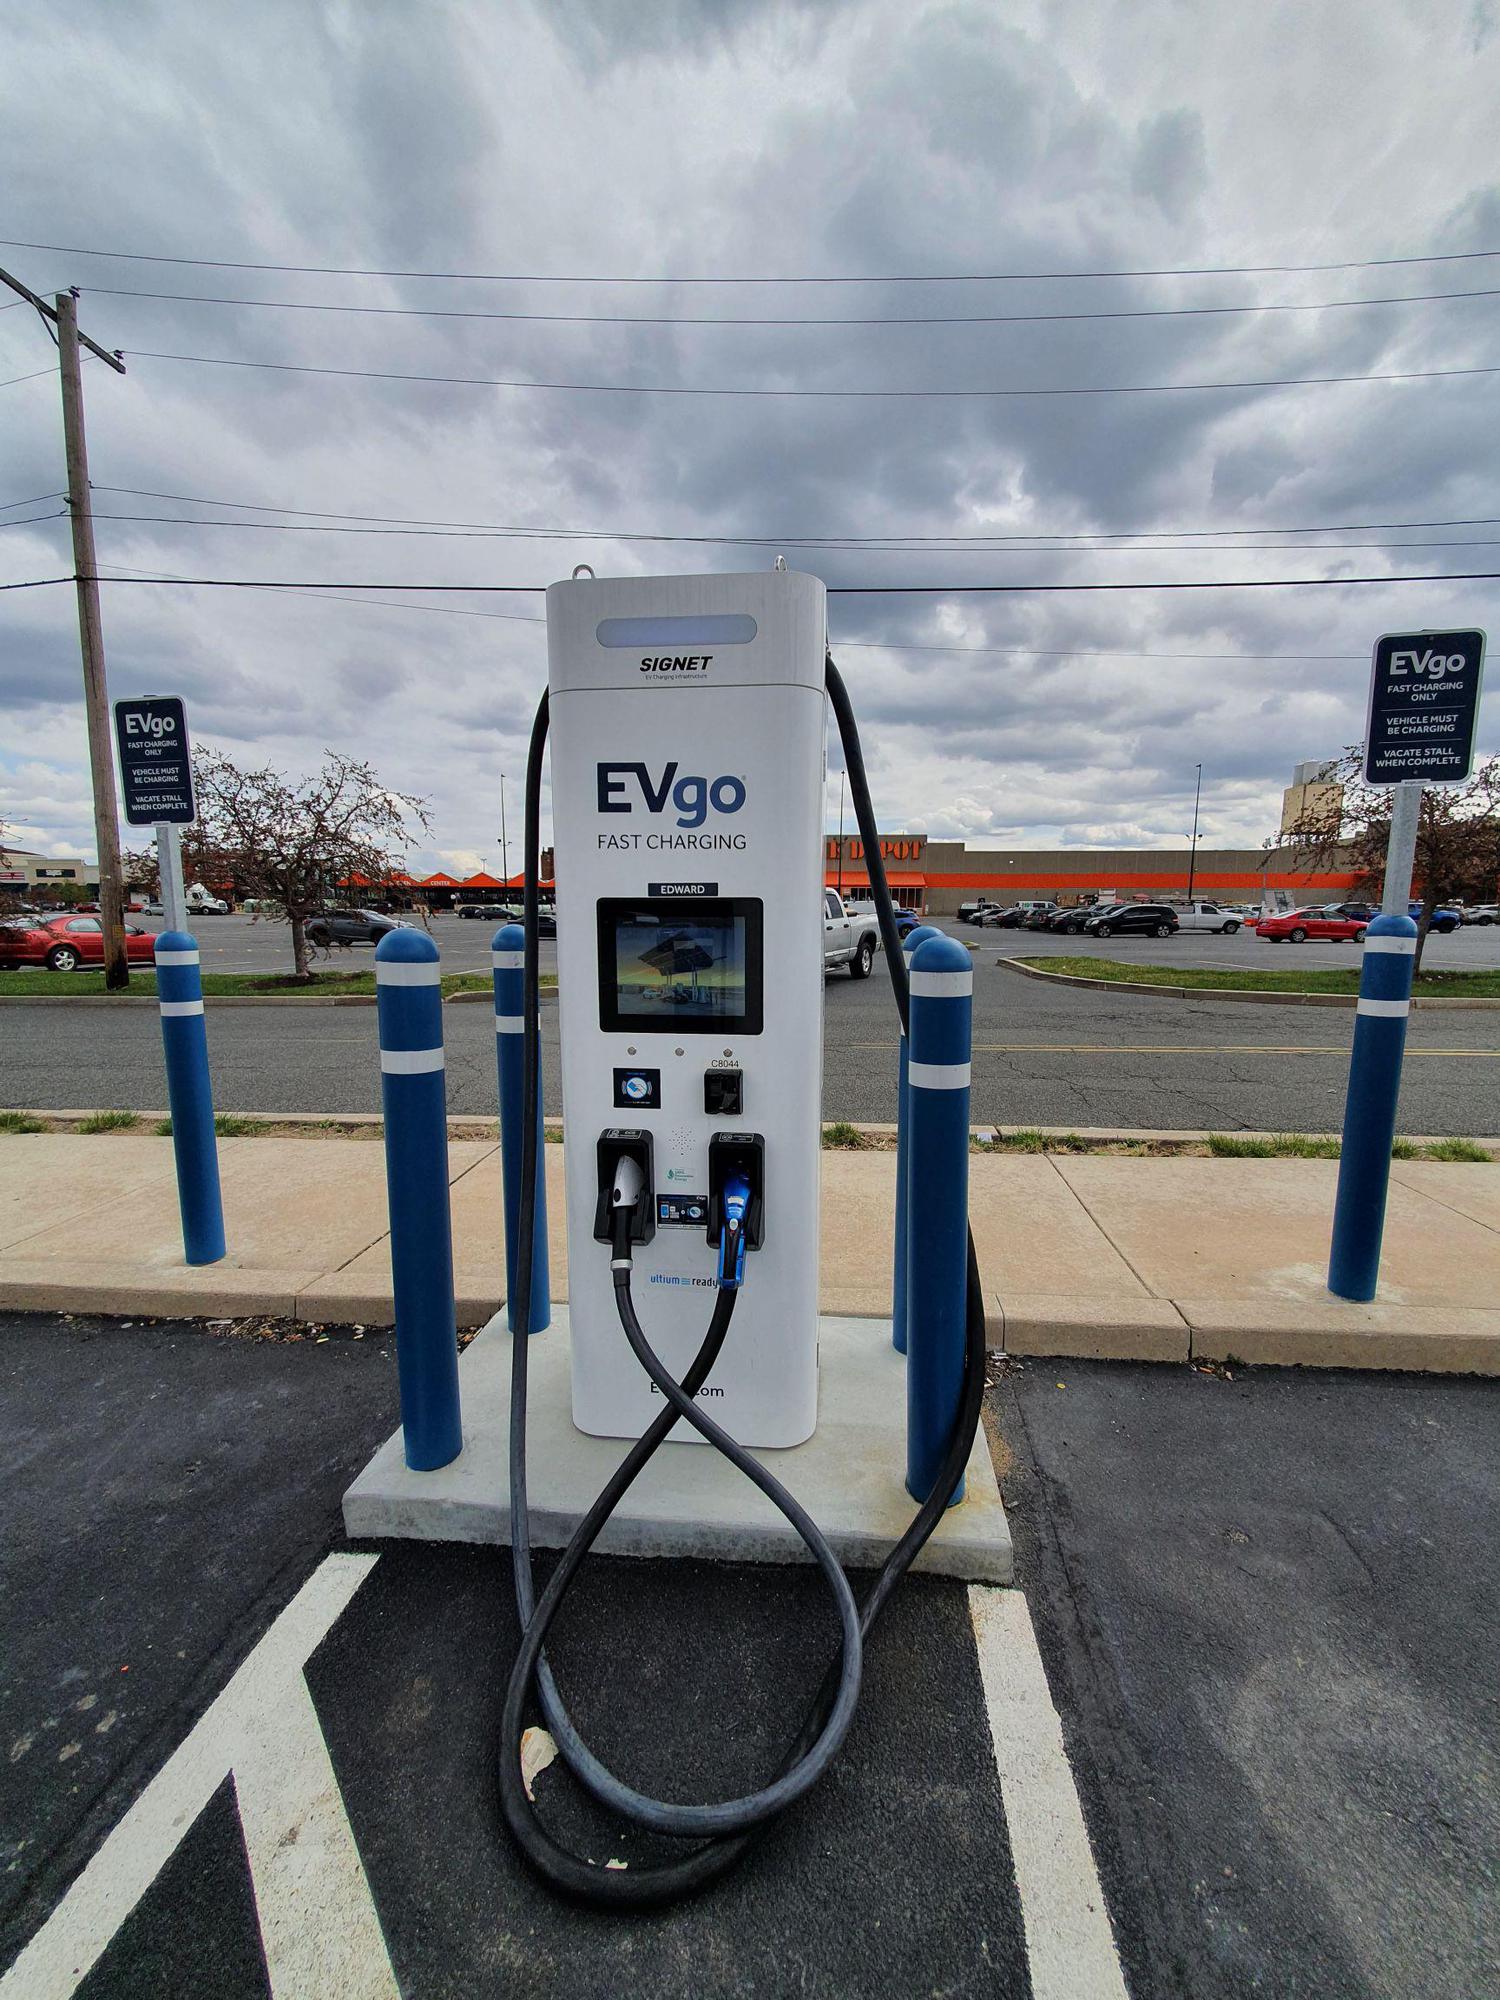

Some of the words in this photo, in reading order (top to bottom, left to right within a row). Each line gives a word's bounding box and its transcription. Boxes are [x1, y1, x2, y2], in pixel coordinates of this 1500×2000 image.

[640, 656, 713, 672] SIGNET
[1389, 649, 1466, 680] EVgo
[1387, 683, 1412, 694] FAST
[1412, 681, 1464, 692] CHARGING
[1411, 692, 1438, 702] ONLY
[125, 713, 176, 738] EVgo
[1386, 715, 1429, 726] VEHICLE
[1430, 714, 1459, 724] MUST
[1387, 726, 1400, 735] BE
[1401, 723, 1456, 734] CHARGING
[128, 741, 144, 749] FAST
[144, 740, 178, 748] CHARGING
[1384, 748, 1422, 758] VACATE
[1423, 747, 1455, 757] STALL
[1376, 758, 1406, 767] WHEN
[1406, 756, 1461, 767] COMPLETE
[132, 768, 160, 776] VEHICLE
[160, 767, 180, 775] MUST
[134, 776, 143, 784] BE
[143, 775, 179, 784] CHARGING
[135, 795, 161, 803] VACATE
[161, 794, 183, 802] STALL
[597, 762, 747, 828] EVgo
[132, 803, 152, 811] WHEN
[152, 802, 188, 810] COMPLETE
[598, 834, 641, 850] FAST
[646, 834, 747, 850] CHARGING
[850, 840, 922, 860] DPOT
[660, 885, 705, 894] EDWARD
[711, 1059, 739, 1068] C8044
[650, 1274, 680, 1285] ultium
[692, 1277, 718, 1289] ready
